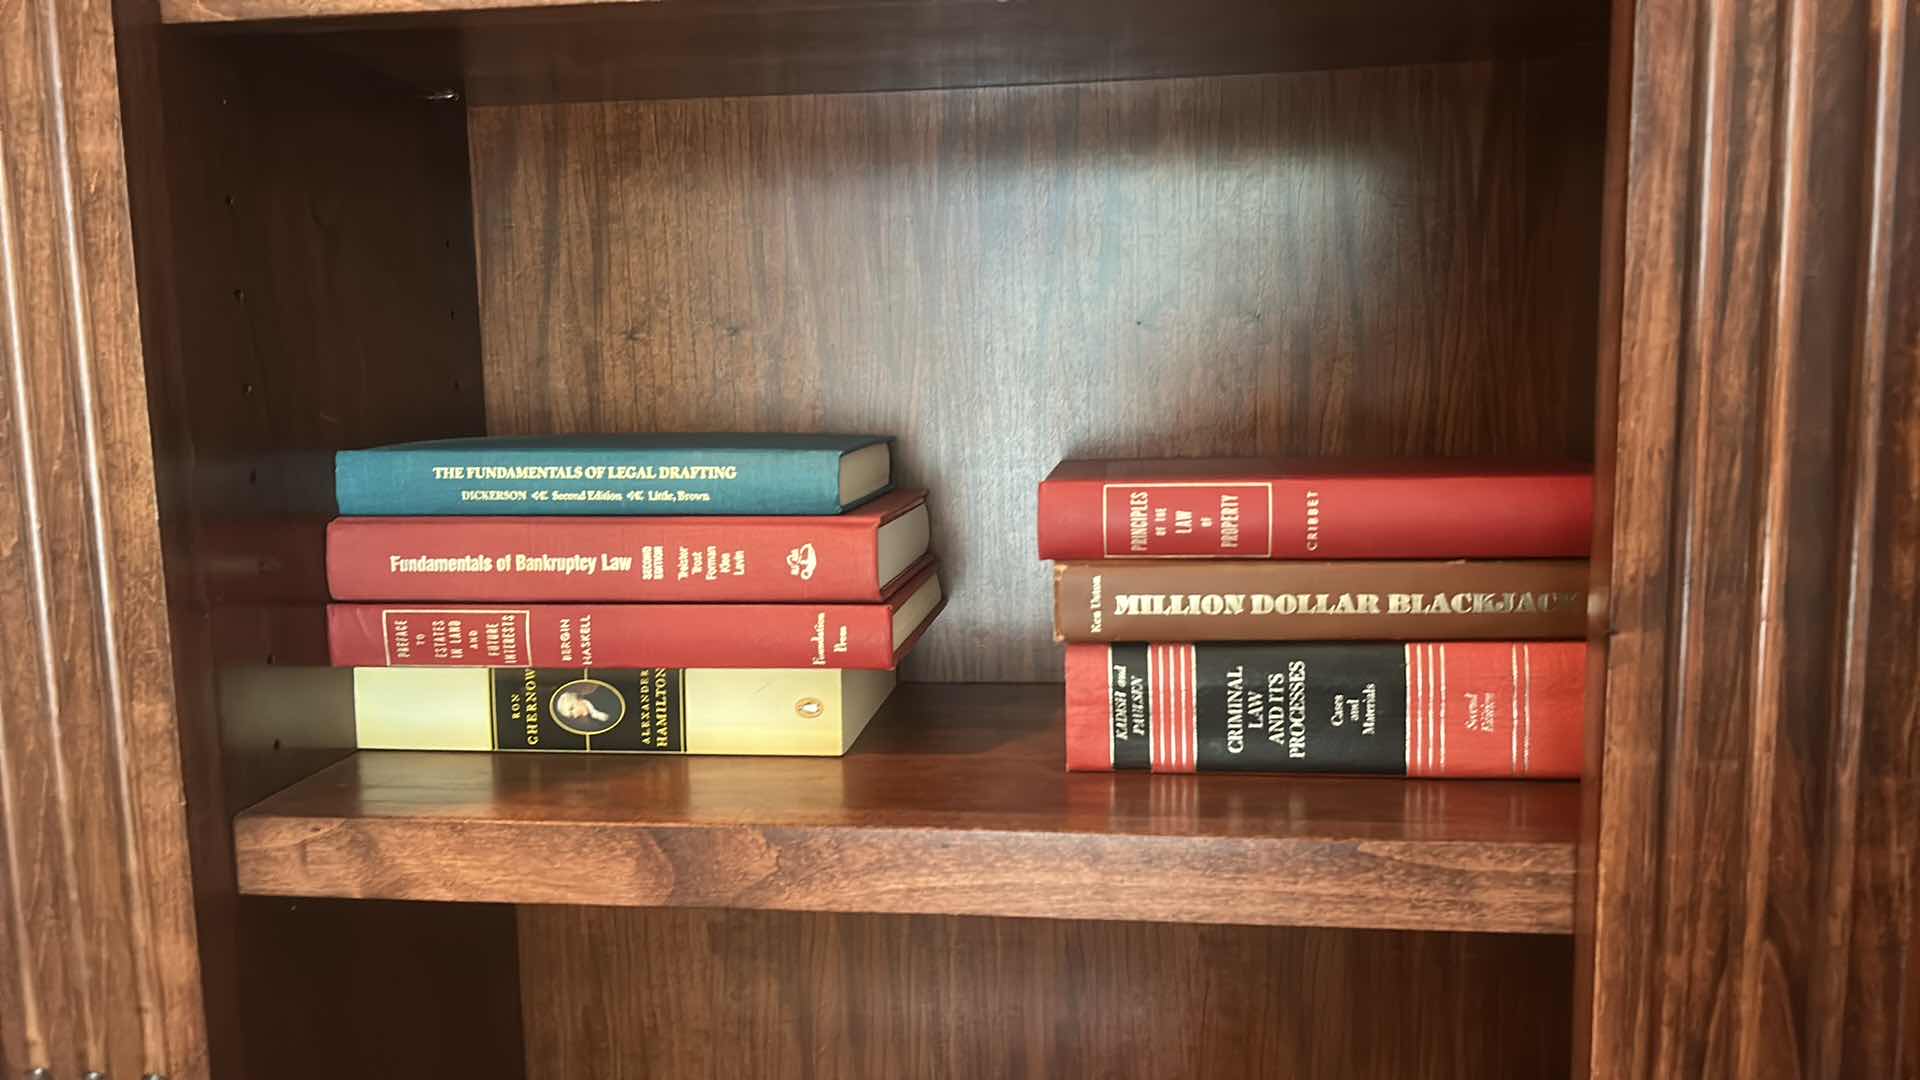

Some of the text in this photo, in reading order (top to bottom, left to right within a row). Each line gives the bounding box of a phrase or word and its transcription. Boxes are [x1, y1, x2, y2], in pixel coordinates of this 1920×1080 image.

[432, 466, 737, 480] THE FUNDAMENTALS OF LEGAL DRAFTING
[461, 490, 527, 501] DICKERSON
[551, 490, 586, 501] Second
[587, 490, 623, 501] Edition
[677, 490, 710, 502] Brown
[1155, 507, 1168, 522] THE
[1130, 491, 1149, 551] PRINCIPLES
[1175, 510, 1193, 534] LAW
[1200, 516, 1213, 528] OF
[1220, 494, 1239, 548] PROPERTY
[1306, 490, 1320, 551] CRIBBET
[389, 554, 632, 575] Fundamentals of Bankruptcy Law
[641, 546, 652, 580] SECOND
[653, 546, 664, 580] EDITION
[705, 546, 717, 580] Forman
[1090, 609, 1102, 632] Ken
[1114, 594, 1245, 615] MILLION
[1250, 593, 1379, 615] DOLLAR
[394, 620, 410, 658] PREFACE
[416, 633, 425, 647] TO
[432, 620, 448, 658] ESTATES
[448, 620, 463, 658] IN LAND
[469, 629, 479, 650] AND
[486, 623, 500, 656] FUTURE
[501, 614, 517, 664] INTERESTS
[560, 618, 571, 661] BERGIN
[579, 614, 593, 665] HASKELL
[810, 612, 826, 665] Foundation
[511, 693, 521, 720] RON
[525, 669, 539, 746] CHERNOW
[640, 670, 653, 745] ALEXANDER
[655, 668, 669, 748] HAMILTON
[1113, 664, 1129, 740] KADISH and
[1132, 674, 1146, 736] PAULSEN
[1227, 666, 1244, 754] CRIMINAL
[1248, 690, 1263, 729] LAW
[1268, 672, 1285, 745] AND ITS
[1288, 660, 1306, 759] PROCESSES
[1331, 694, 1344, 727] Cases
[1347, 699, 1359, 720] and
[1361, 683, 1376, 735] Materials
